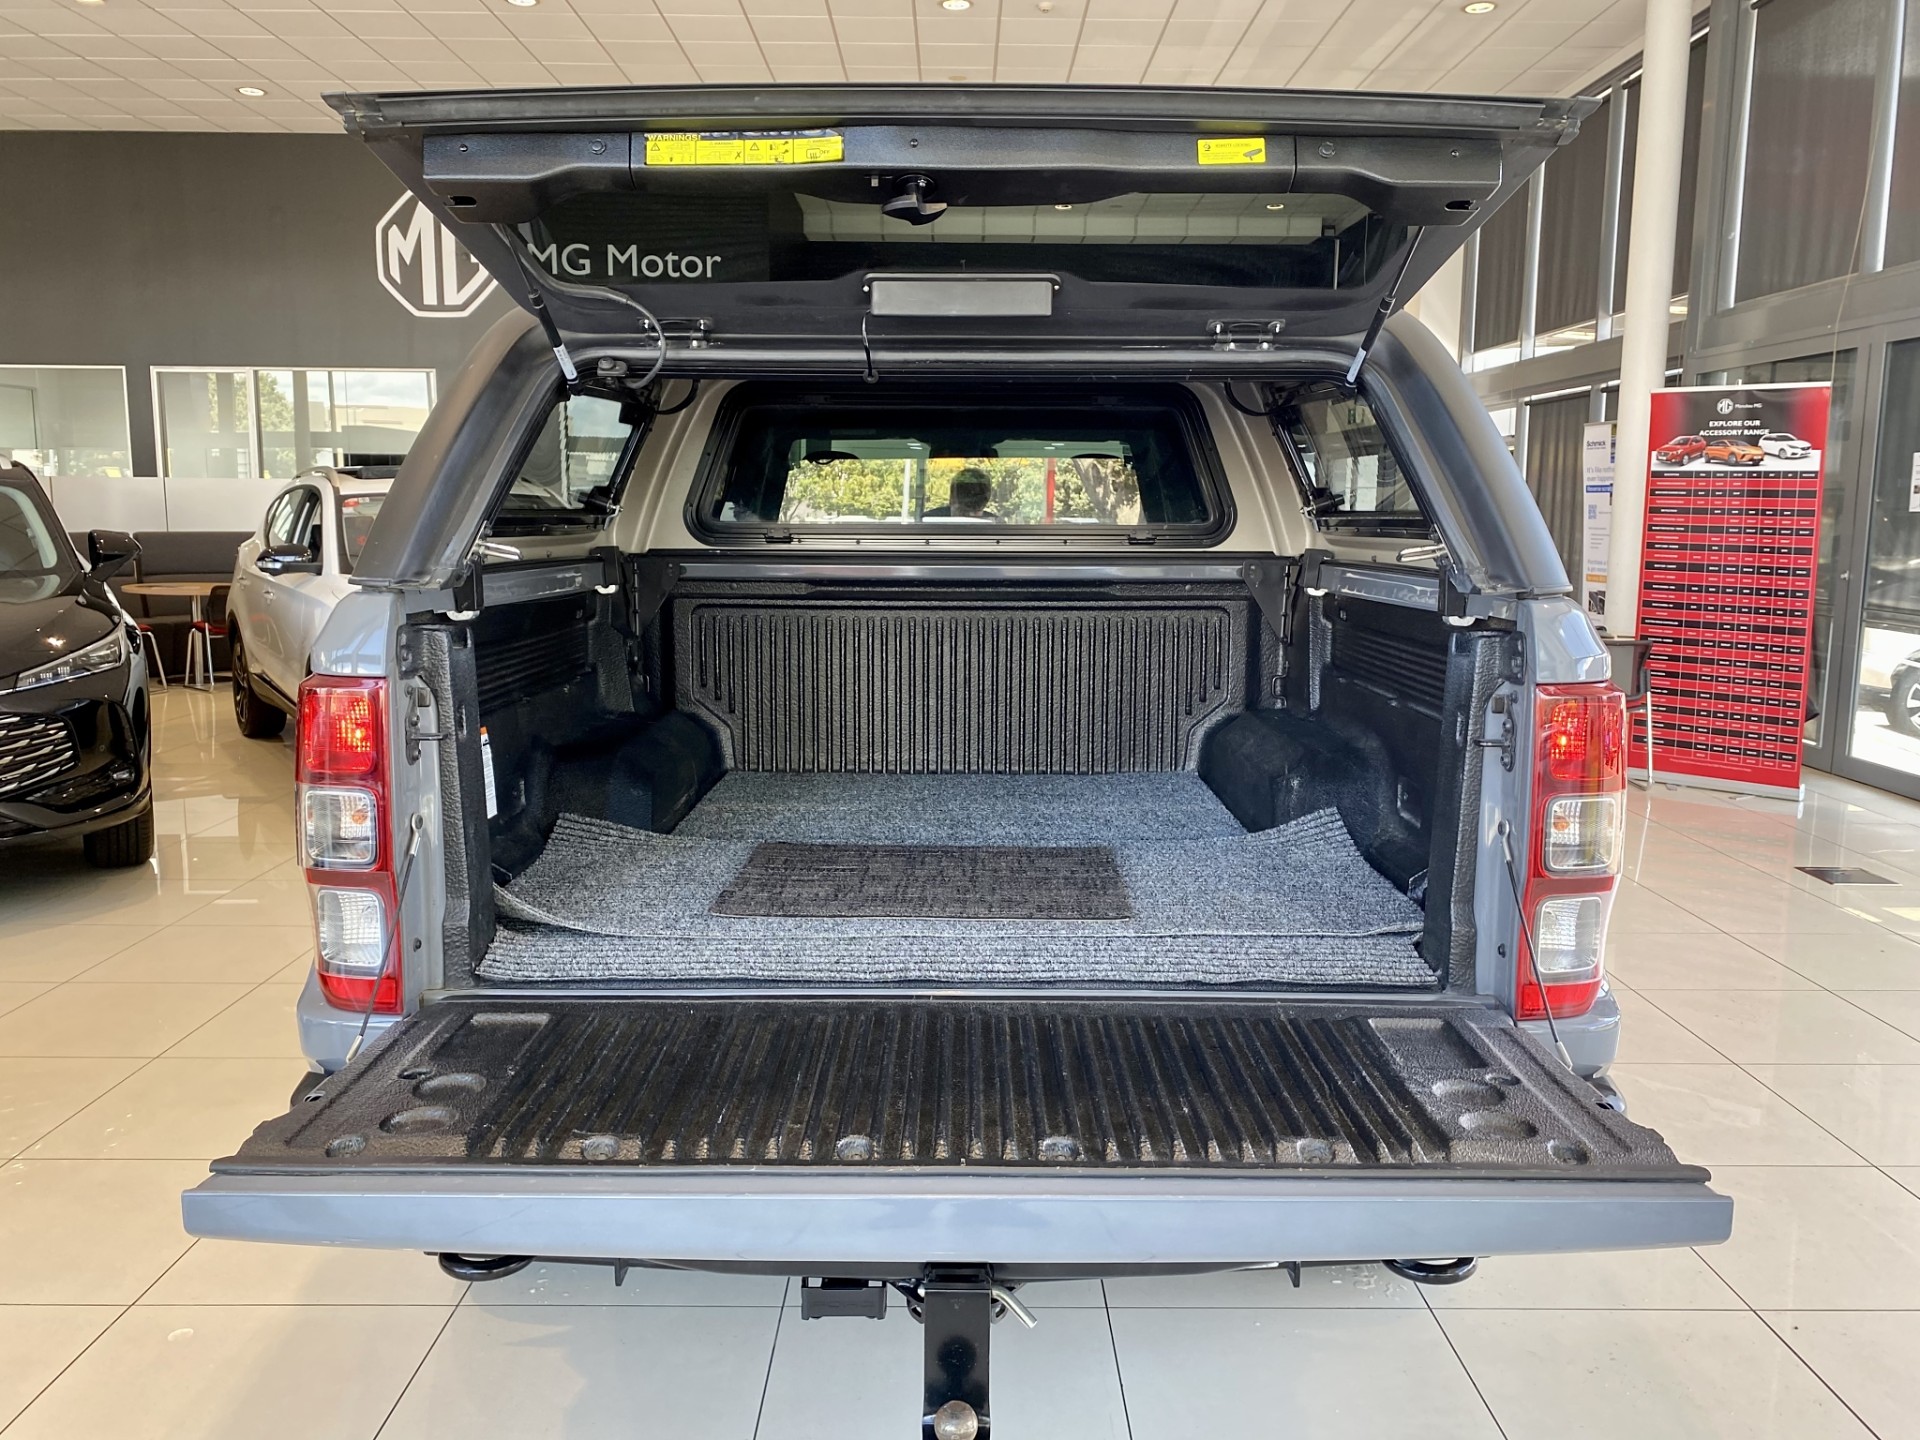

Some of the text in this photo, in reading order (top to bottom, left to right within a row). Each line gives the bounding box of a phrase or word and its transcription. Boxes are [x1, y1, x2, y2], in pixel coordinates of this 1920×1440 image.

[647, 133, 701, 141] WARNINGS!
[527, 243, 722, 278] MG Motor
[1716, 398, 1734, 415] MG
